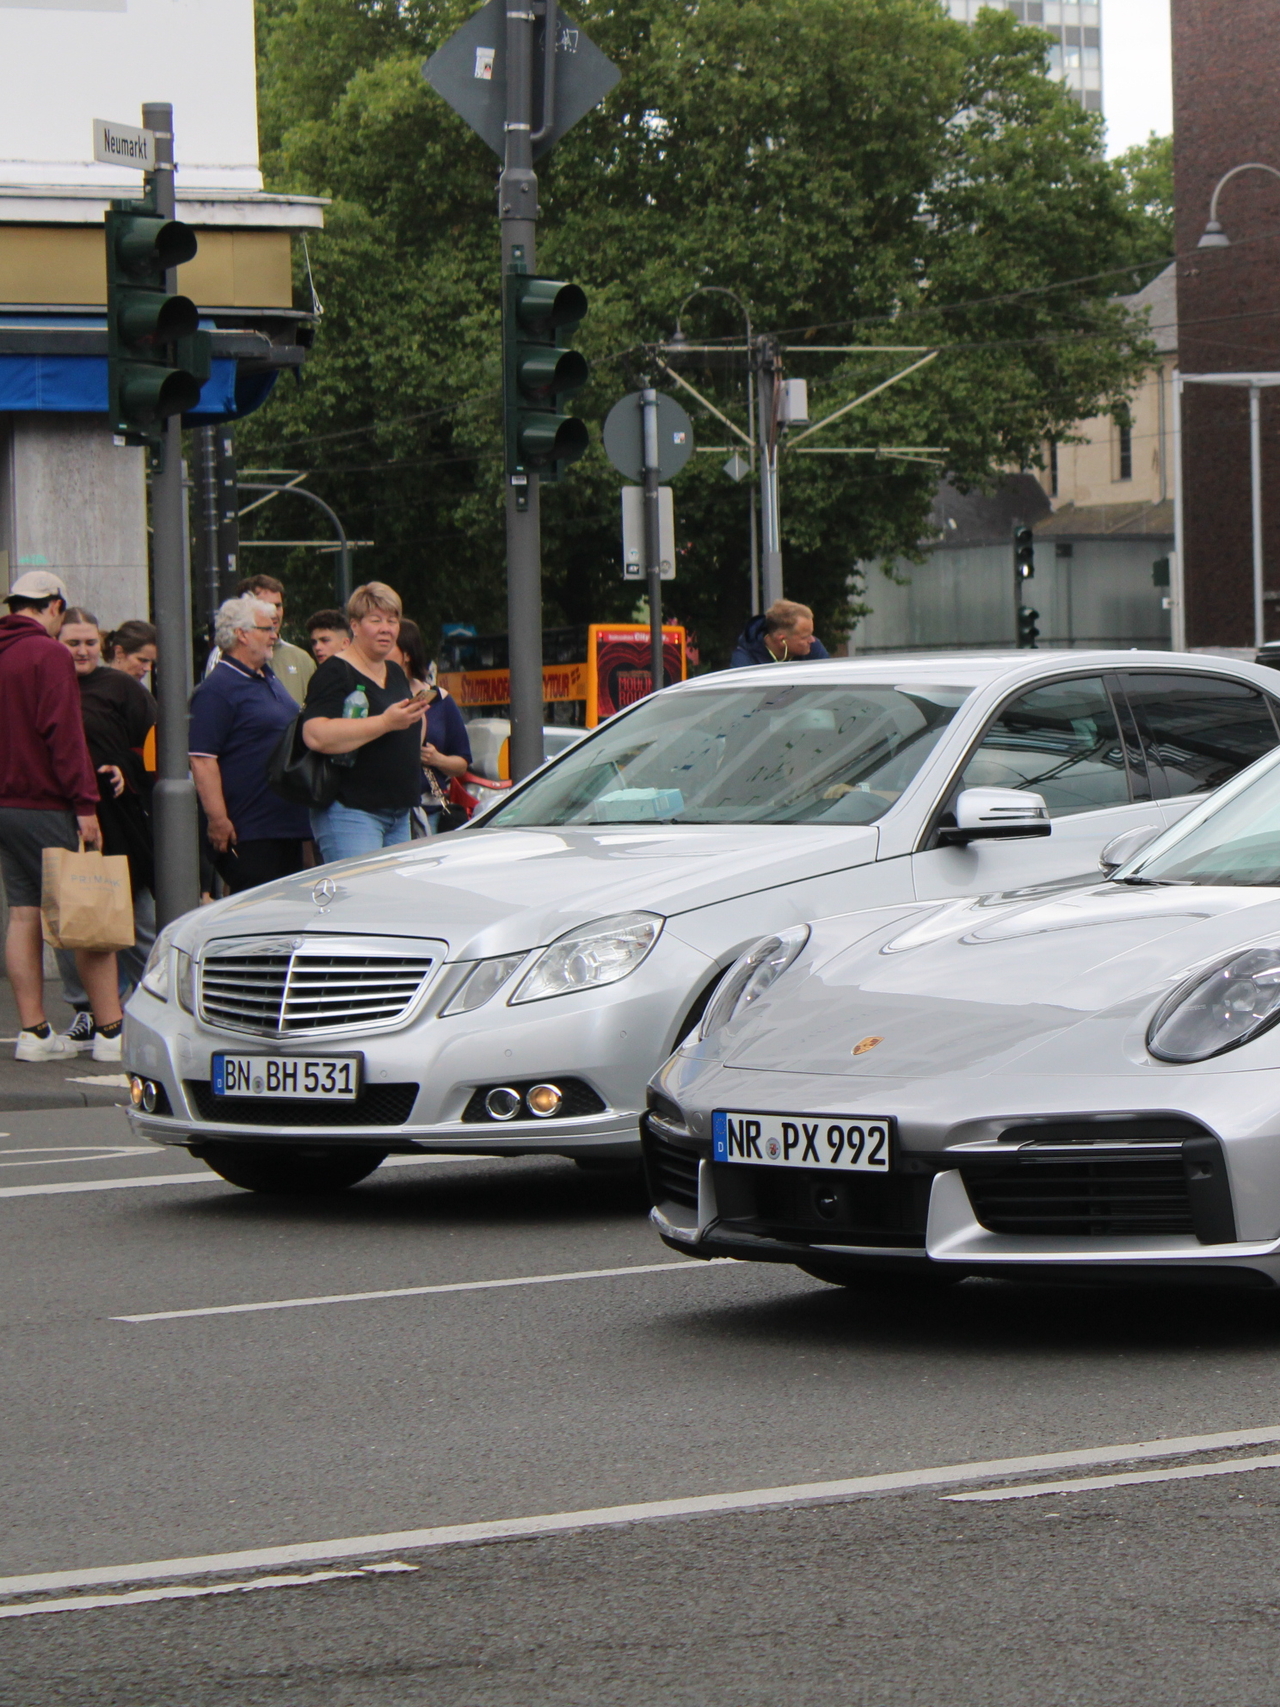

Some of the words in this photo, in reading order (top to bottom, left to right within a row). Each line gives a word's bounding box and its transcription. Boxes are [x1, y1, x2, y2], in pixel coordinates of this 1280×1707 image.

[103, 128, 148, 160] Neumarkt
[225, 1059, 251, 1091] BN
[266, 1060, 298, 1092] BH
[304, 1062, 354, 1094] 531
[717, 1141, 724, 1153] D
[728, 1118, 763, 1160] NR
[781, 1121, 820, 1163] PX
[827, 1124, 886, 1166] 992
